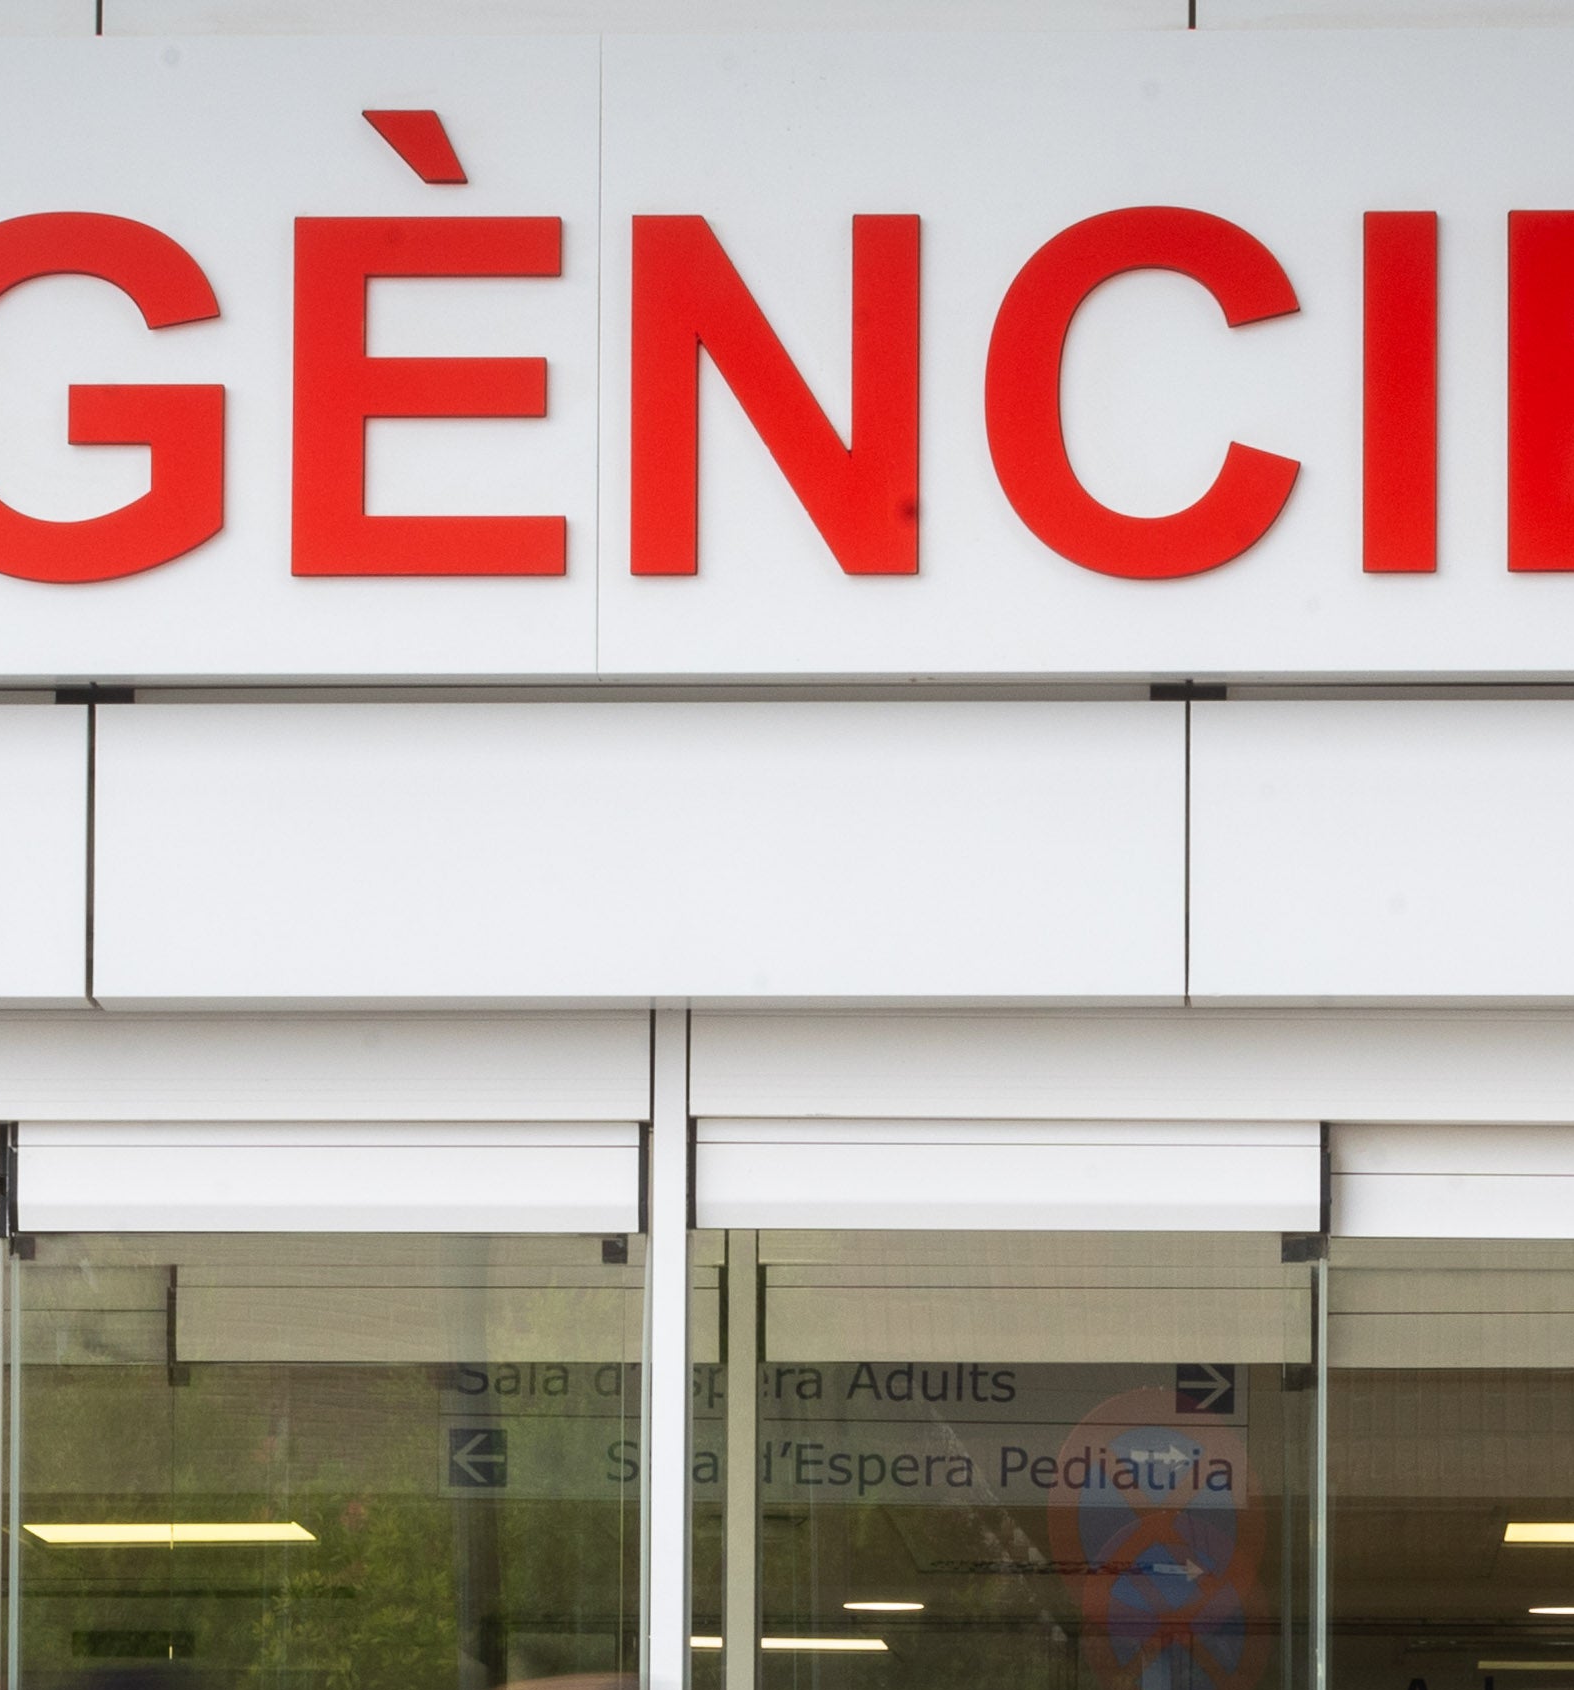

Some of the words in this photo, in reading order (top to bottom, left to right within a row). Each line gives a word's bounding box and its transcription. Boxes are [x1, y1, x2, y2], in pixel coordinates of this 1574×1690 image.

[455, 1362, 569, 1398] Sala
[846, 1360, 1016, 1403] Adults
[999, 1445, 1235, 1492] Pediatria
